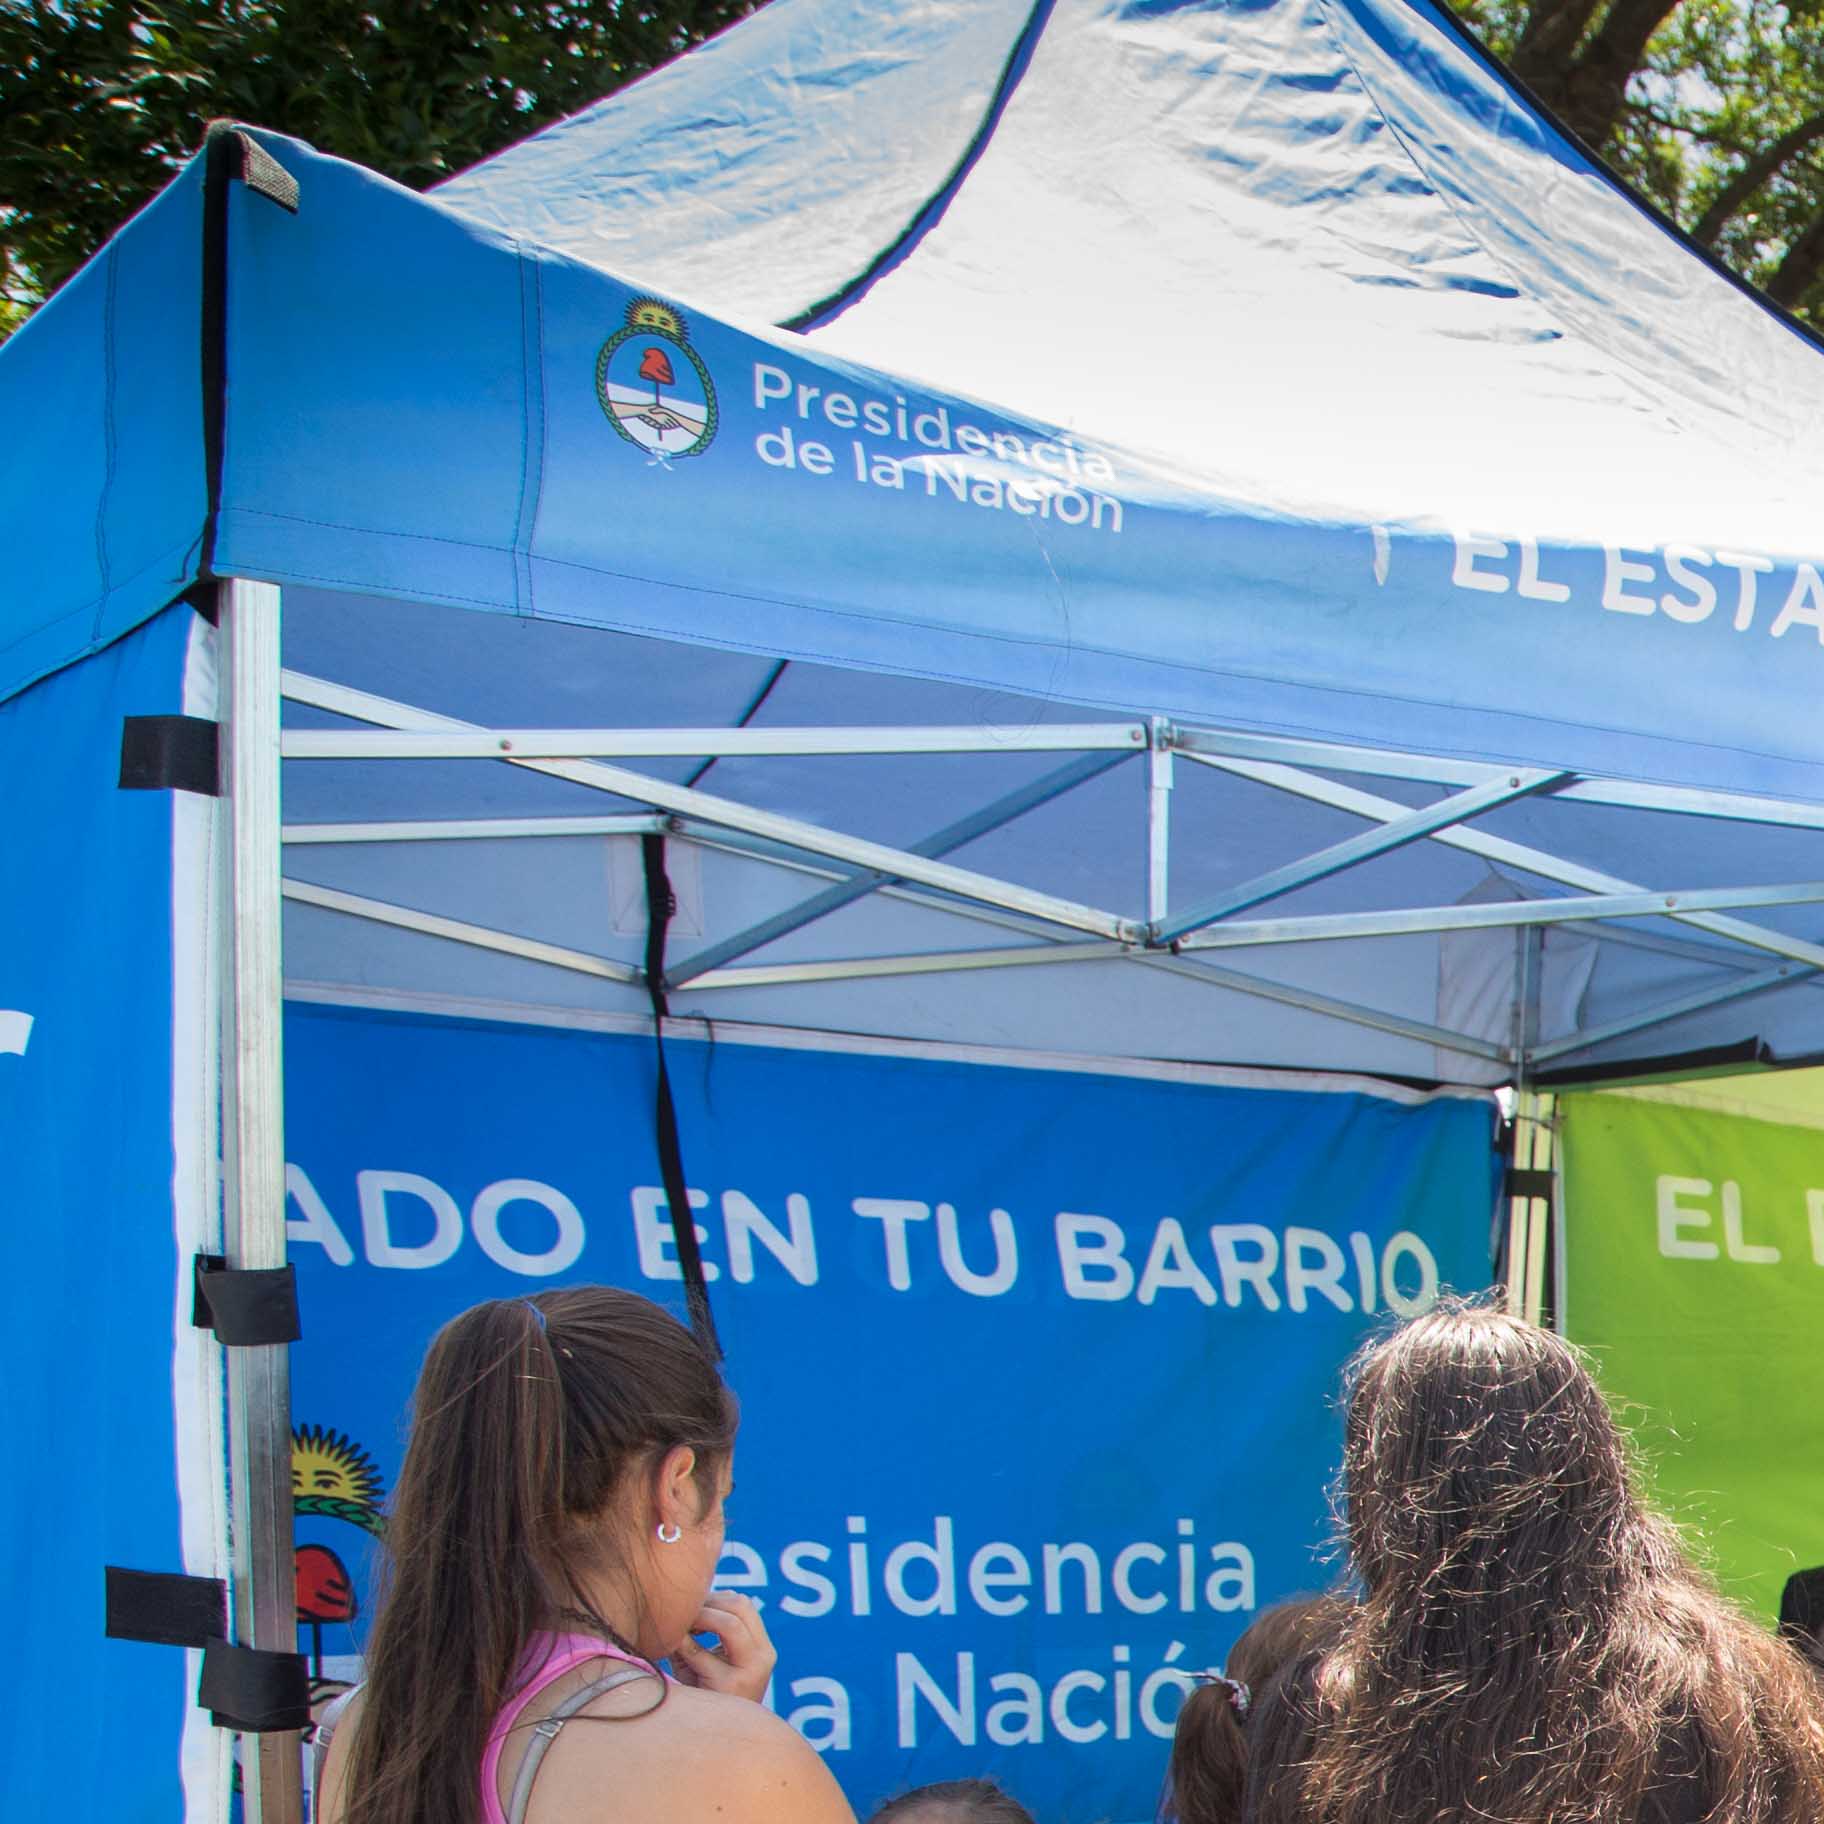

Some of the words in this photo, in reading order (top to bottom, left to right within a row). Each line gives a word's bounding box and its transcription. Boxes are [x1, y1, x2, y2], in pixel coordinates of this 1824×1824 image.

[753, 362, 1116, 484] Presidencia
[755, 426, 835, 476] de
[852, 441, 905, 490] la
[923, 455, 1124, 533] Nación
[1453, 527, 1571, 603] EL
[629, 1186, 818, 1287] EN
[853, 1197, 1019, 1297] TU
[1053, 1209, 1438, 1318] BARRIO
[1656, 1174, 1779, 1266] EL
[896, 1640, 1221, 1749] Nació
